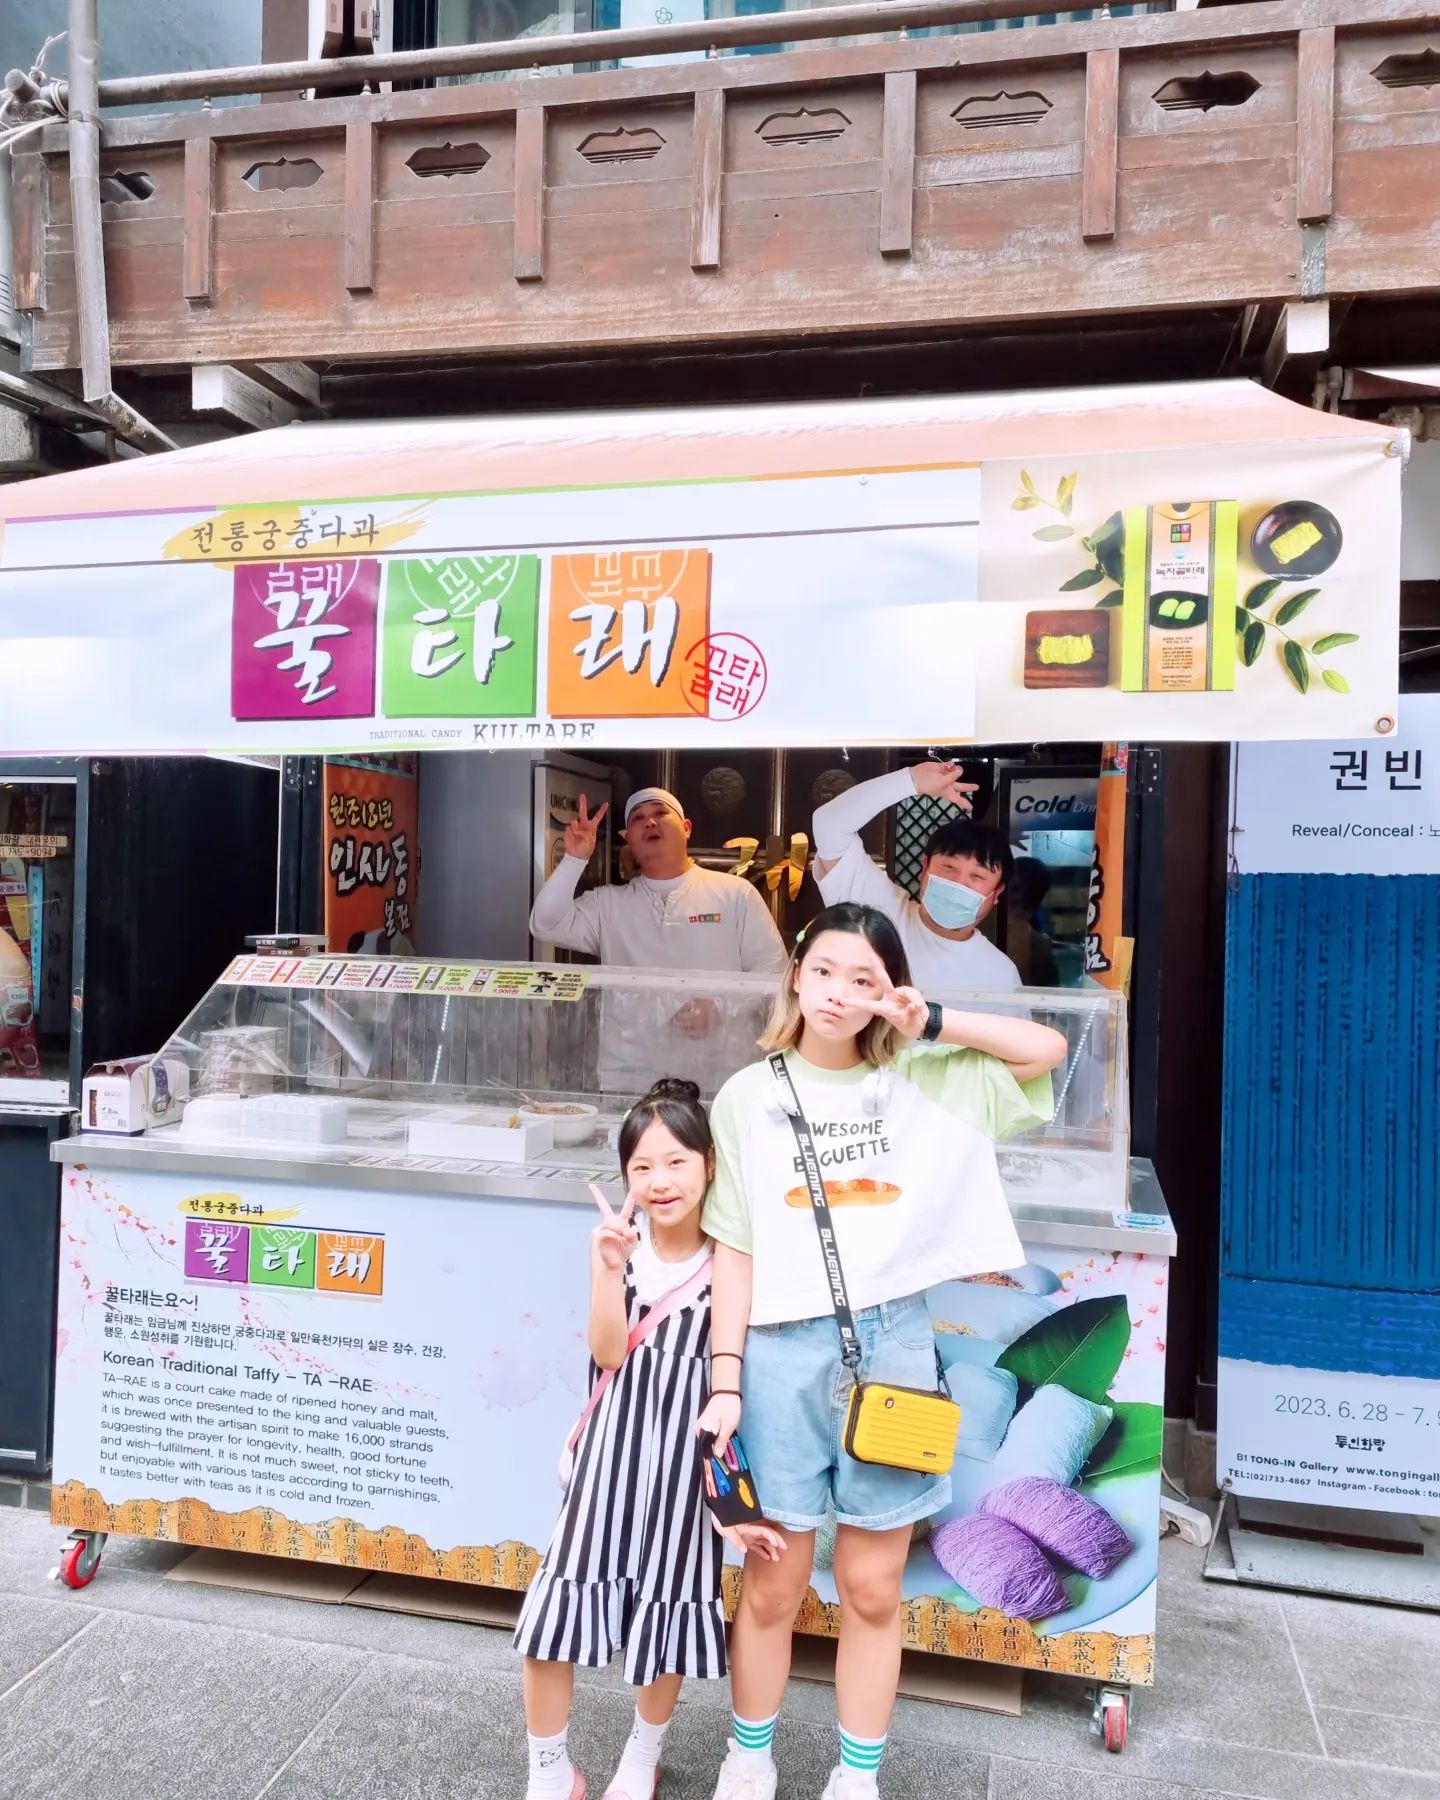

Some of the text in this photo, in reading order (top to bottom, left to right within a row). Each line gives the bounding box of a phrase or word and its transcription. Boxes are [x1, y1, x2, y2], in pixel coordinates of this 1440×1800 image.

[190, 513, 380, 553] 전통궁중다과
[369, 729, 426, 740] TRADITIONAL
[431, 729, 462, 739] CANDY
[329, 793, 394, 830] 원조18년
[1015, 795, 1076, 814] Cold
[1292, 823, 1414, 838] Reveal/Conceal
[330, 834, 409, 897] 인사동
[384, 899, 411, 937] 본점
[805, 1121, 883, 1137] WESOME
[793, 1137, 891, 1173] BGUETTE
[188, 1199, 265, 1217] 전통궁중다과
[103, 1312, 144, 1326] 꿀타래는
[147, 1316, 187, 1330] 임금님께
[190, 1321, 230, 1335] 진상하던
[235, 1326, 286, 1340] 궁중다과로
[290, 1332, 363, 1349] 일만육천가닥의
[366, 1339, 388, 1352] 실은
[130, 1329, 179, 1344] 소원성취를
[103, 1350, 154, 1367] Korean
[160, 1356, 237, 1376] Traditional
[243, 1365, 280, 1383] Taffy
[301, 1372, 322, 1386] TA
[102, 1389, 449, 1438] which was once presented to the king and valuable guests,
[151, 1378, 160, 1388] is
[174, 1383, 204, 1393] court
[208, 1386, 236, 1397] cake
[239, 1390, 272, 1401] made
[276, 1393, 287, 1403] of
[291, 1395, 336, 1408] ripened
[340, 1400, 377, 1414] honey
[381, 1406, 404, 1416] and
[409, 1409, 437, 1421] malt,
[1275, 1395, 1331, 1417] 2023.
[1362, 1403, 1388, 1422] 28
[100, 1421, 427, 1467] suggesting the prayer for longevity, health, good fortune
[101, 1403, 433, 1452] it is brewed with the artisan spirit to make 16,000 strands
[1335, 1435, 1386, 1452] 통인화랑
[100, 1435, 121, 1445] and
[218, 1448, 224, 1458] It
[228, 1449, 238, 1460] is
[242, 1453, 260, 1462] not
[264, 1456, 296, 1467] much
[300, 1461, 338, 1473] sweet,
[343, 1466, 362, 1475] not
[365, 1468, 400, 1481] sticky
[404, 1472, 416, 1482] to
[419, 1474, 453, 1488] teeth,
[100, 1449, 440, 1502] but enjoyable with various tastes according to garnishings.
[1237, 1453, 1248, 1462] B1
[1251, 1456, 1295, 1468] TONG-IN
[1299, 1460, 1339, 1474] Gallery
[99, 1464, 374, 1509] It tastes better with teas as it is cold and frozen.
[1317, 1479, 1367, 1492] Instagram
[1374, 1484, 1420, 1497] Facebook
